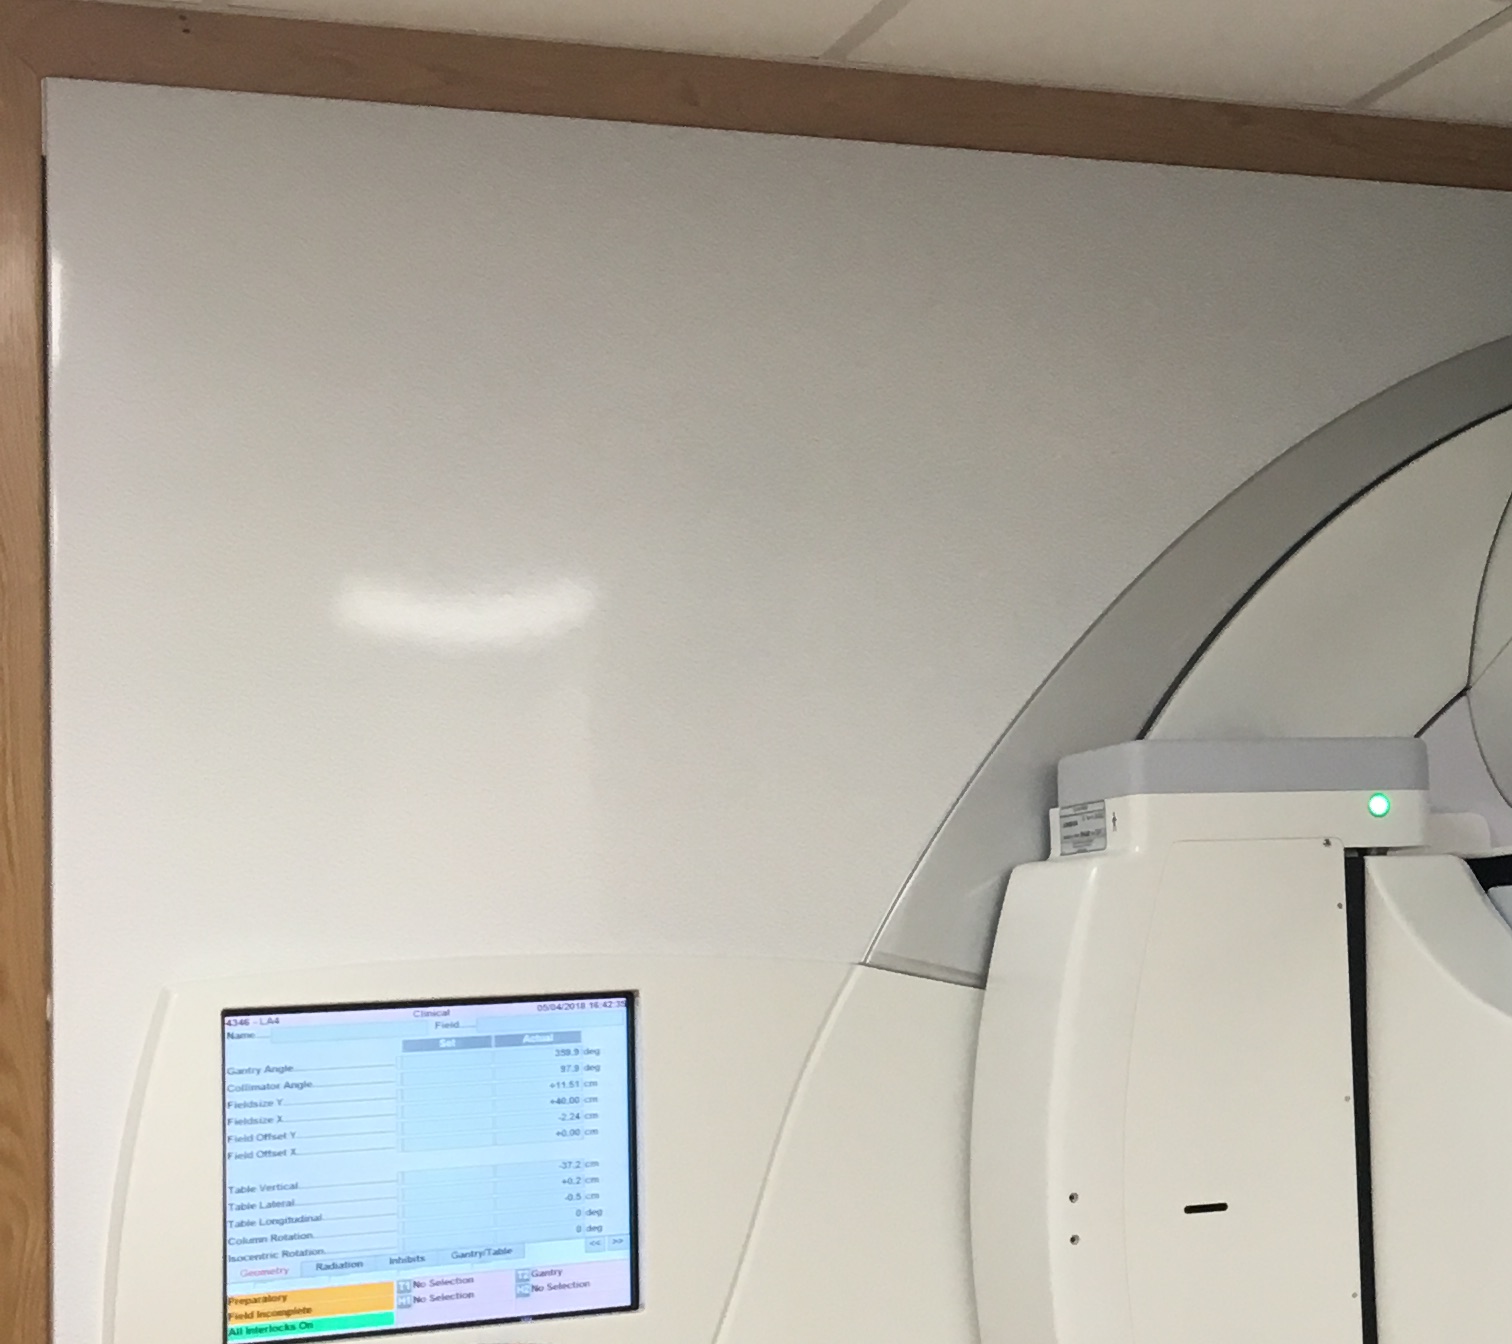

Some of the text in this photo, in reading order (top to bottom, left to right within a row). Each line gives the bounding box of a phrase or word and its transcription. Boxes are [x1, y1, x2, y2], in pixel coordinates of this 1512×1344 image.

[413, 1009, 450, 1018] Clinical
[435, 1021, 460, 1030] Field
[227, 1031, 256, 1040] Name
[522, 1033, 554, 1044] Actual
[439, 1038, 456, 1047] Set
[583, 1047, 600, 1056] deg
[227, 1064, 294, 1077] Gantry Angle
[583, 1064, 601, 1073] deg
[227, 1080, 313, 1093] Collimator Angle
[227, 1099, 274, 1109] Fieldsize
[583, 1096, 599, 1104] cm
[227, 1115, 283, 1126] Fieldsize X
[584, 1112, 599, 1120] cm
[227, 1134, 254, 1143] Field
[256, 1132, 287, 1142] Offset
[584, 1128, 599, 1136] cm
[227, 1148, 297, 1160] Field Offset X
[585, 1160, 599, 1168] cm
[228, 1182, 298, 1195] Table Vertical
[585, 1192, 600, 1200] cm
[228, 1198, 295, 1211] Table Lateral
[585, 1208, 603, 1218] deg
[228, 1214, 323, 1229] Table Longitudinal
[586, 1223, 603, 1233] deg
[228, 1232, 314, 1246] Column Rotation
[228, 1247, 324, 1263] Isocentric Rotation
[451, 1247, 513, 1260] Gantry/Table
[315, 1260, 364, 1271] Radiation
[389, 1255, 425, 1265] Inhibits
[240, 1267, 289, 1278] Geometry
[531, 1269, 563, 1278] Gantry
[413, 1280, 427, 1288] No
[429, 1277, 475, 1287] Selection
[531, 1284, 544, 1292] No
[547, 1281, 591, 1291] Selection
[228, 1294, 288, 1306] Preparatory
[413, 1295, 427, 1304] No
[429, 1292, 475, 1302] Selection
[228, 1307, 312, 1322] Field Incomplete
[228, 1321, 314, 1337] All Interlocks On
